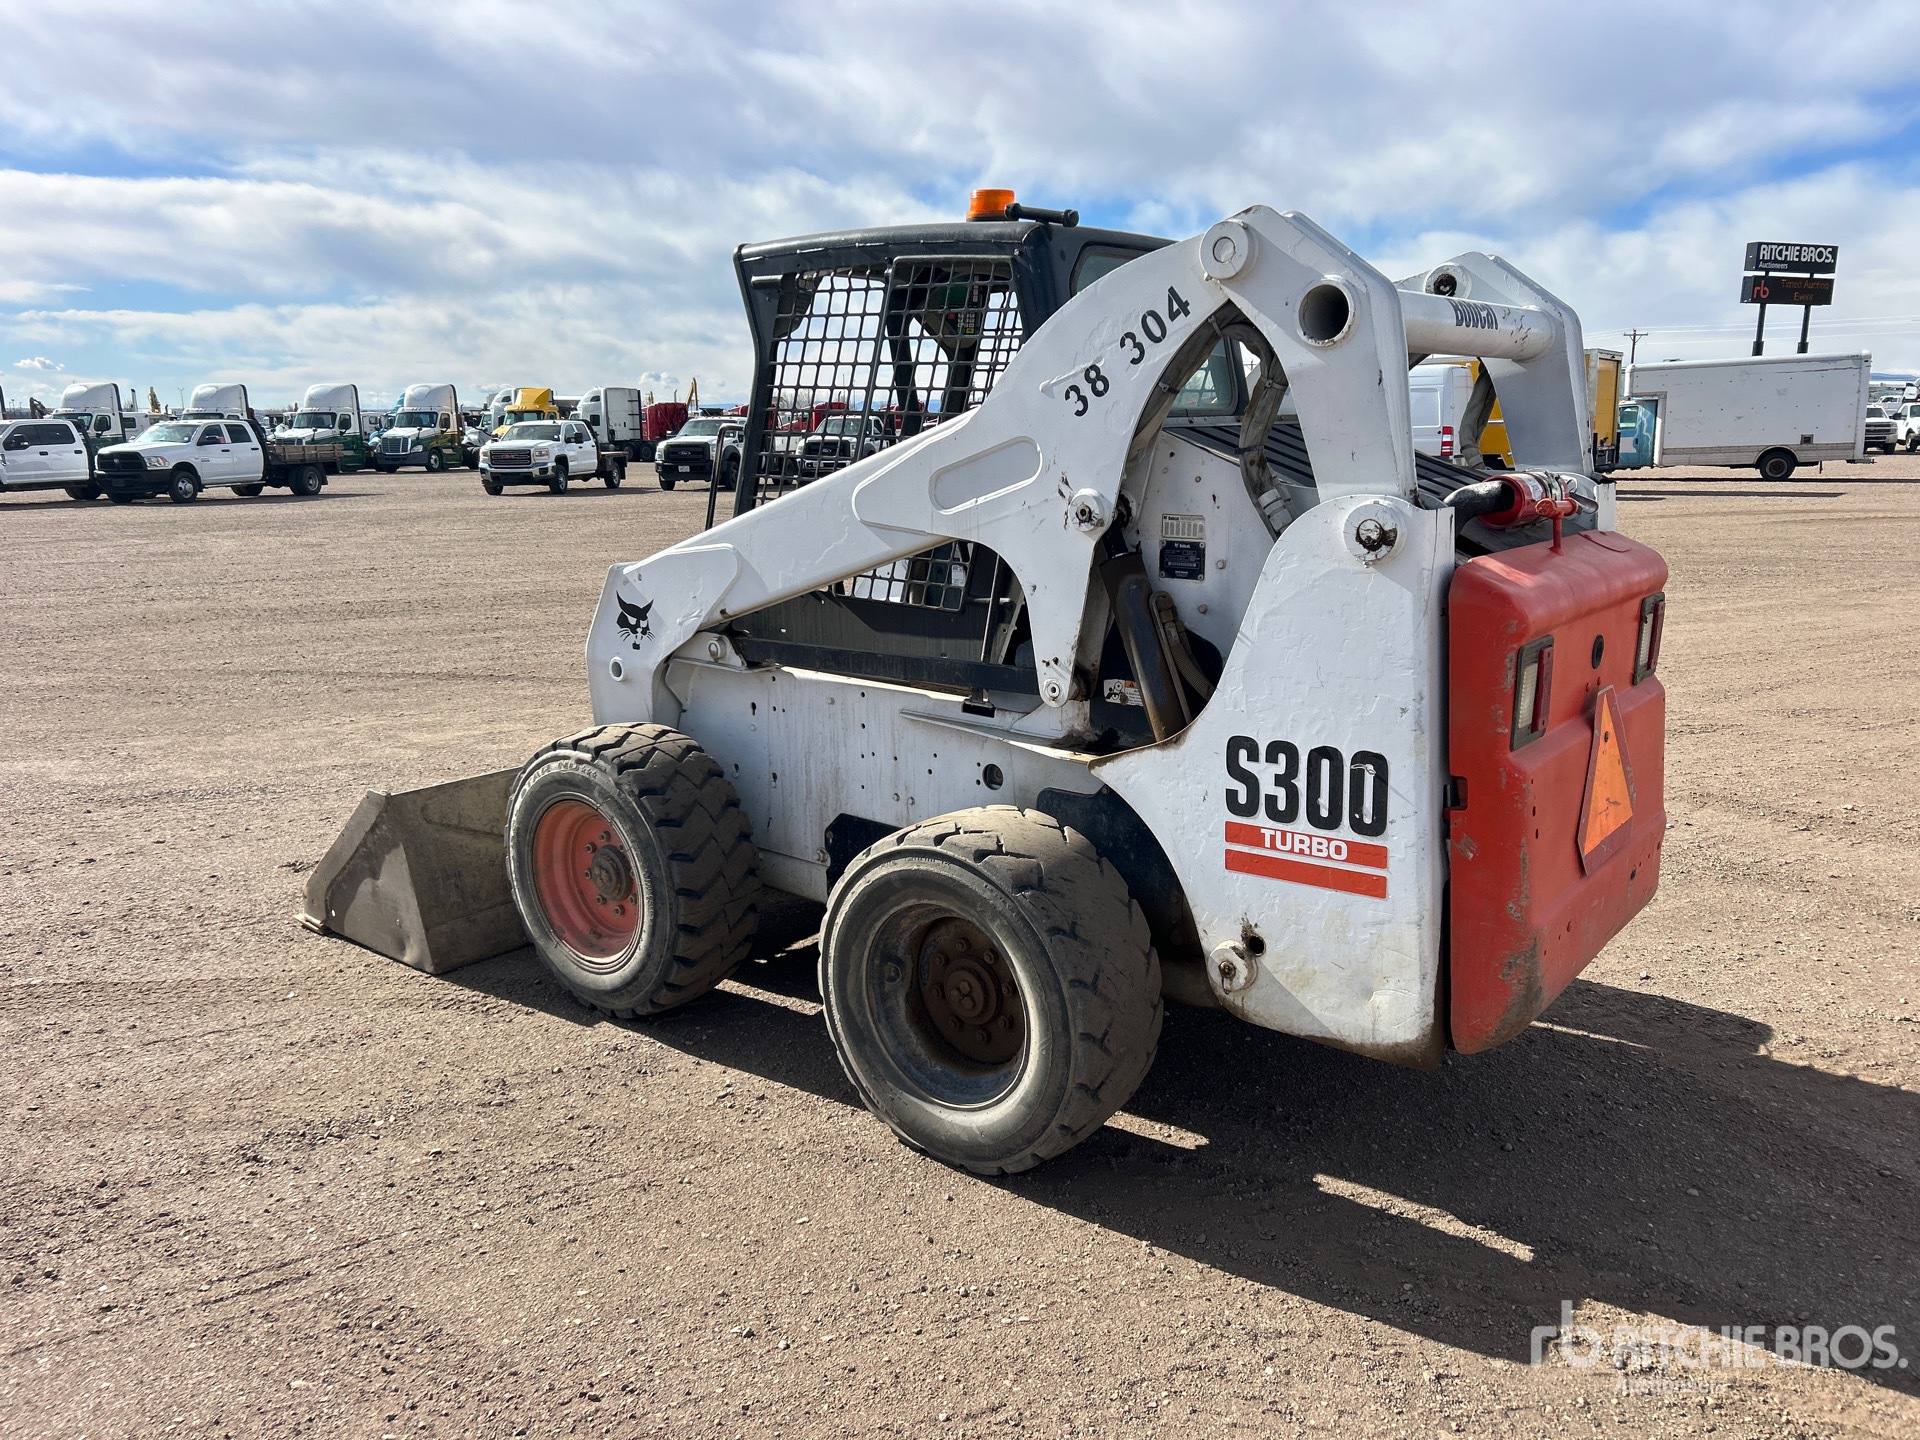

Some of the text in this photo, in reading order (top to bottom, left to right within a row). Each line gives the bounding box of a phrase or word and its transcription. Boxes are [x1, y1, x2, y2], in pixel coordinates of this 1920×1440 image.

[1760, 244, 1834, 263] RITCHIE BROS.
[1759, 261, 1789, 270] Auctioneers
[1754, 280, 1770, 299] rb
[1781, 279, 1829, 290] Timed Auction
[1793, 292, 1814, 301] Event
[1064, 285, 1191, 417] 38 304
[1225, 735, 1389, 837] S300
[1260, 828, 1348, 861] TURBO
